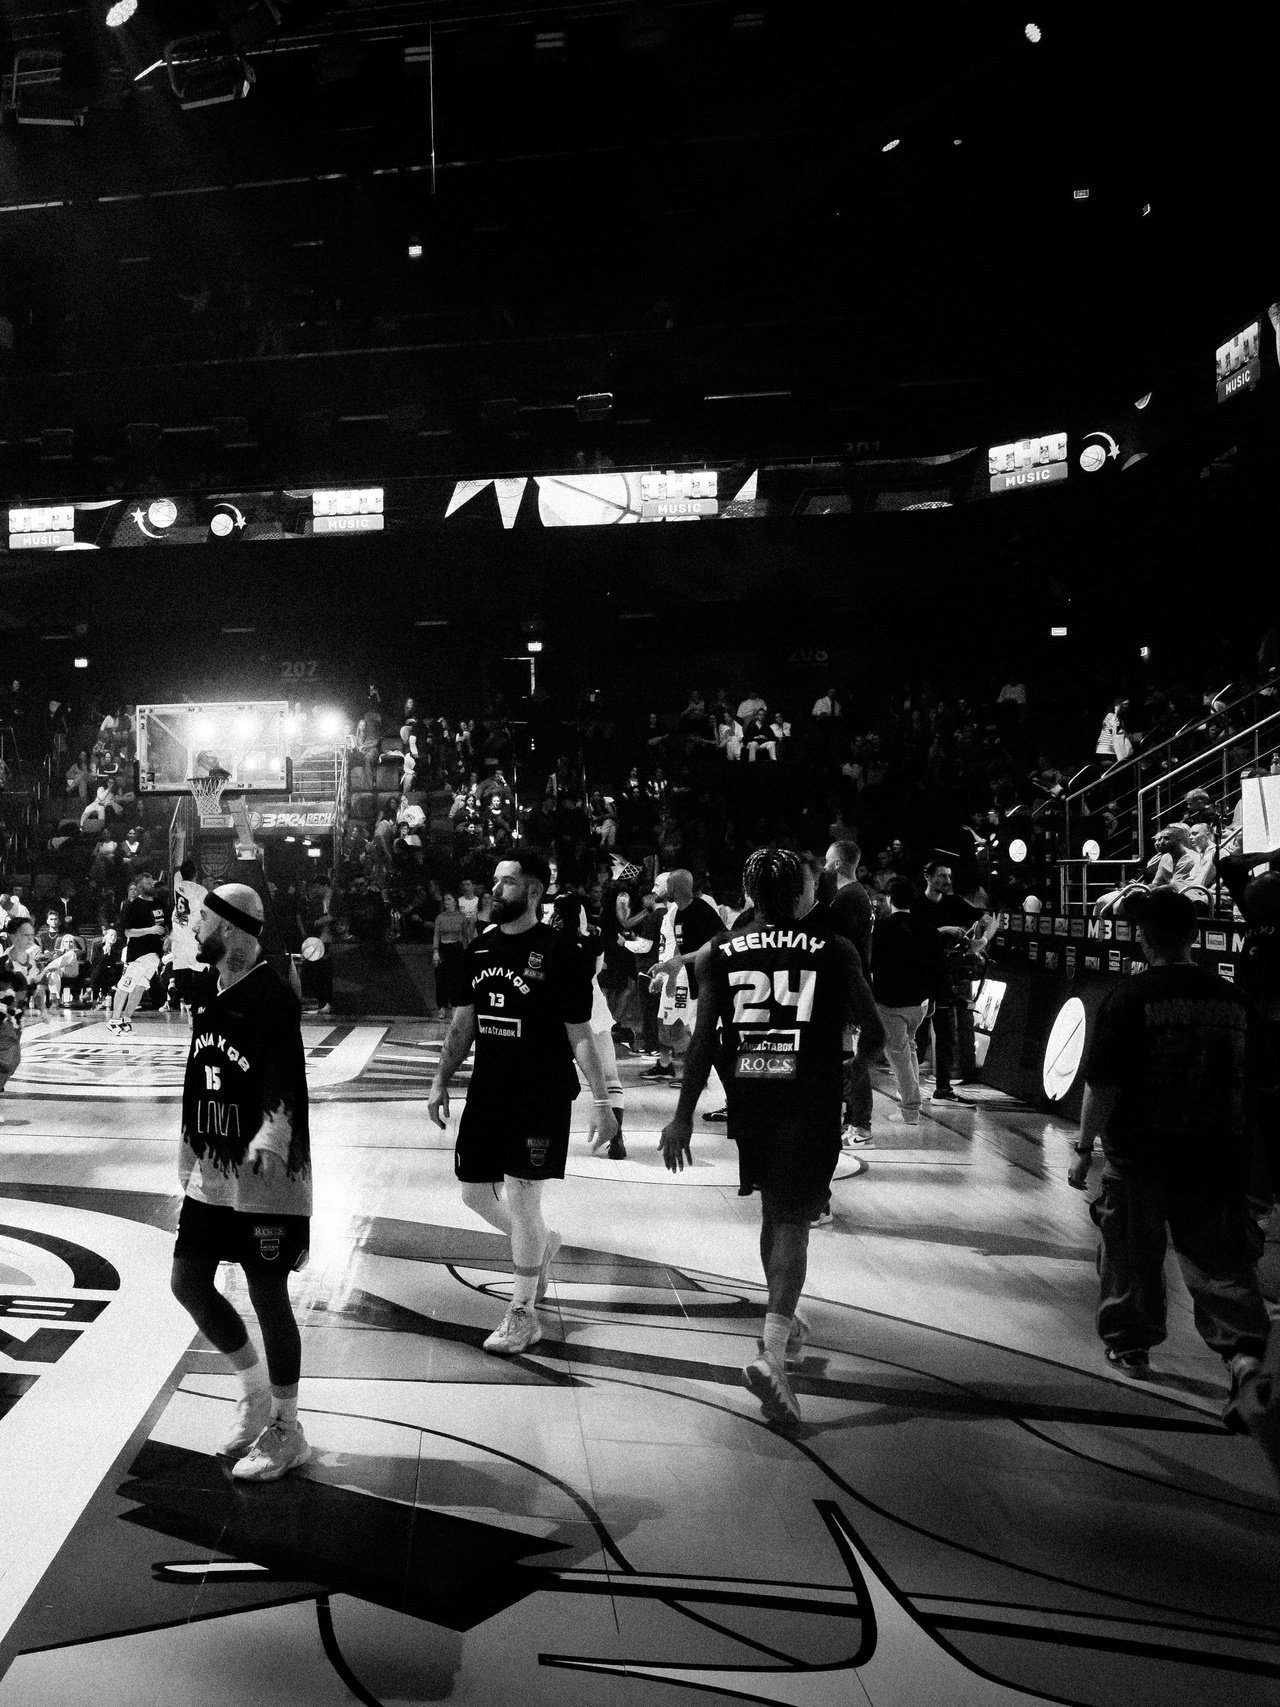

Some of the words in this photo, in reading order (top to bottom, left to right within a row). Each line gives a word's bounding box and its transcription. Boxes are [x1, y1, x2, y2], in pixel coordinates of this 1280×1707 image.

[1225, 369, 1251, 396] MUSIC
[1005, 469, 1050, 487] MUSIC
[658, 503, 701, 514] MUSIC
[328, 519, 368, 529] MUSIC
[23, 535, 60, 545] MUSIC
[719, 930, 826, 957] TEEKHAY
[488, 991, 505, 1008] 13
[728, 969, 817, 1024] 24
[204, 1064, 222, 1091] 15
